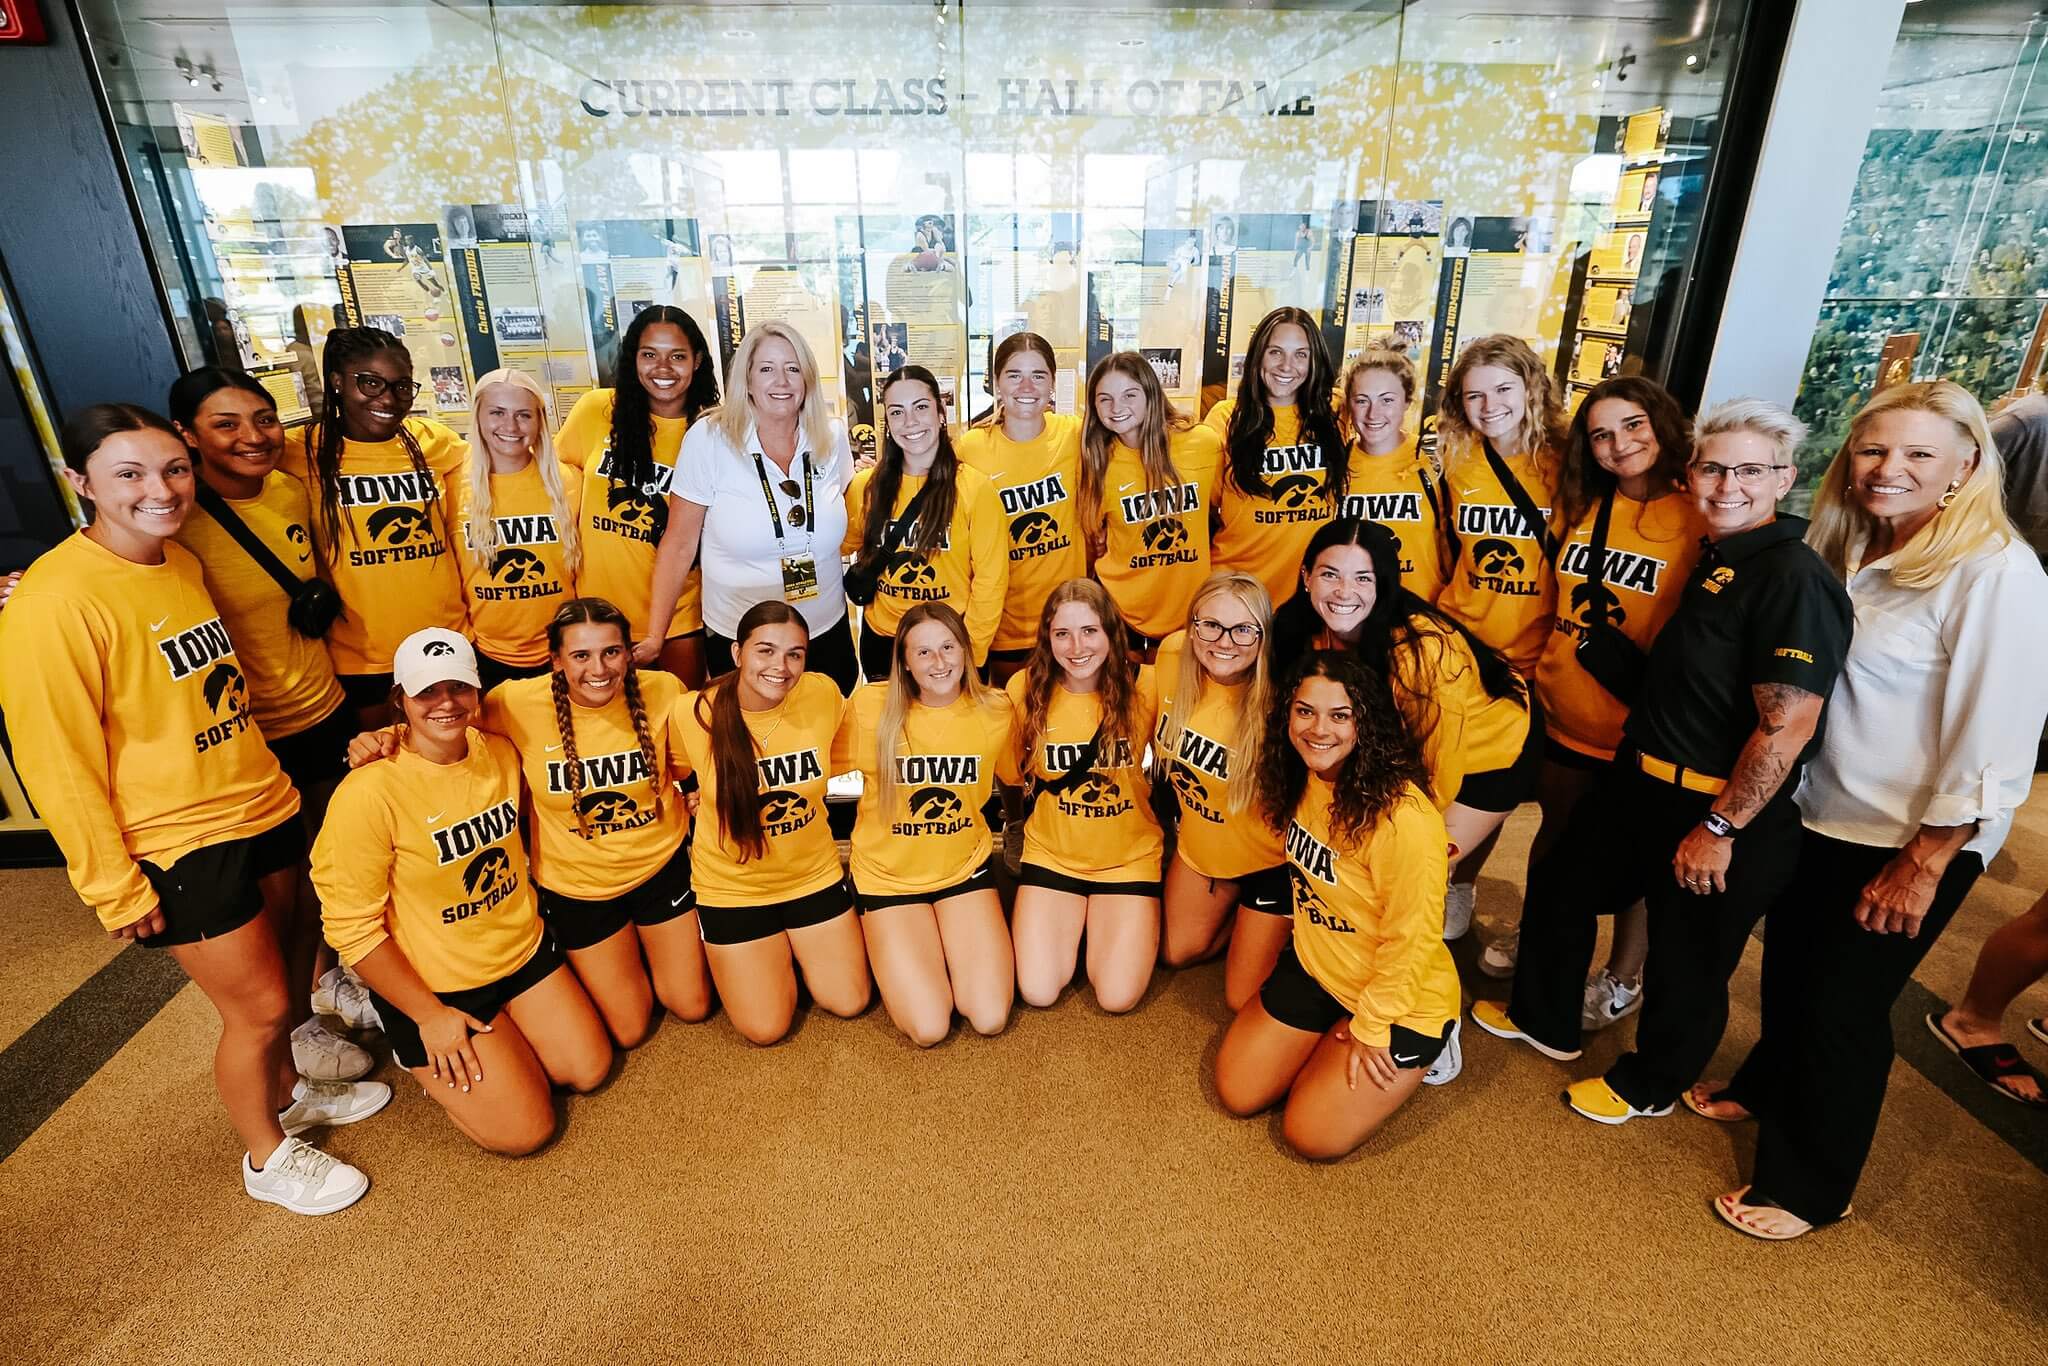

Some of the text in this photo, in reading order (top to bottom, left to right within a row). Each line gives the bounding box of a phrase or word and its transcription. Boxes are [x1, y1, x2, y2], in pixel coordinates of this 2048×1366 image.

[580, 79, 793, 117] CURRENT
[809, 79, 948, 116] CLASS
[998, 79, 1110, 117] HALL
[1127, 79, 1184, 117] OF
[1200, 79, 1316, 117] FAME
[464, 249, 482, 298] FREDDIE
[1446, 258, 1464, 327] BURMEISTER
[726, 278, 742, 344] McFARLAND
[1216, 255, 1231, 357] J. Daniel SHERMAN
[1334, 306, 1344, 328] Eric
[1441, 328, 1454, 360] WEST
[1261, 444, 1327, 475] OW
[337, 470, 441, 508] IOWA
[999, 472, 1068, 515] OWA
[1120, 482, 1200, 525] IOWA
[592, 515, 652, 543] SOFTBA
[1008, 535, 1071, 561] OFTBALL
[350, 540, 447, 567] SOFTBALL
[1129, 549, 1199, 569] SOFTBALL
[474, 581, 563, 601] SOFTBALL
[877, 579, 951, 601] SOFTBALL
[158, 616, 235, 682] IOW
[1155, 712, 1231, 782] IWA
[546, 749, 652, 794] IOWA
[758, 747, 823, 791] WA
[895, 754, 981, 786] IOWA
[761, 807, 818, 838] TBALL
[891, 817, 974, 836] SOFTBALL
[1183, 791, 1225, 824] BALL
[431, 797, 519, 867] IOWA
[1285, 818, 1339, 887] OWA
[441, 872, 519, 925] SOFTBALL
